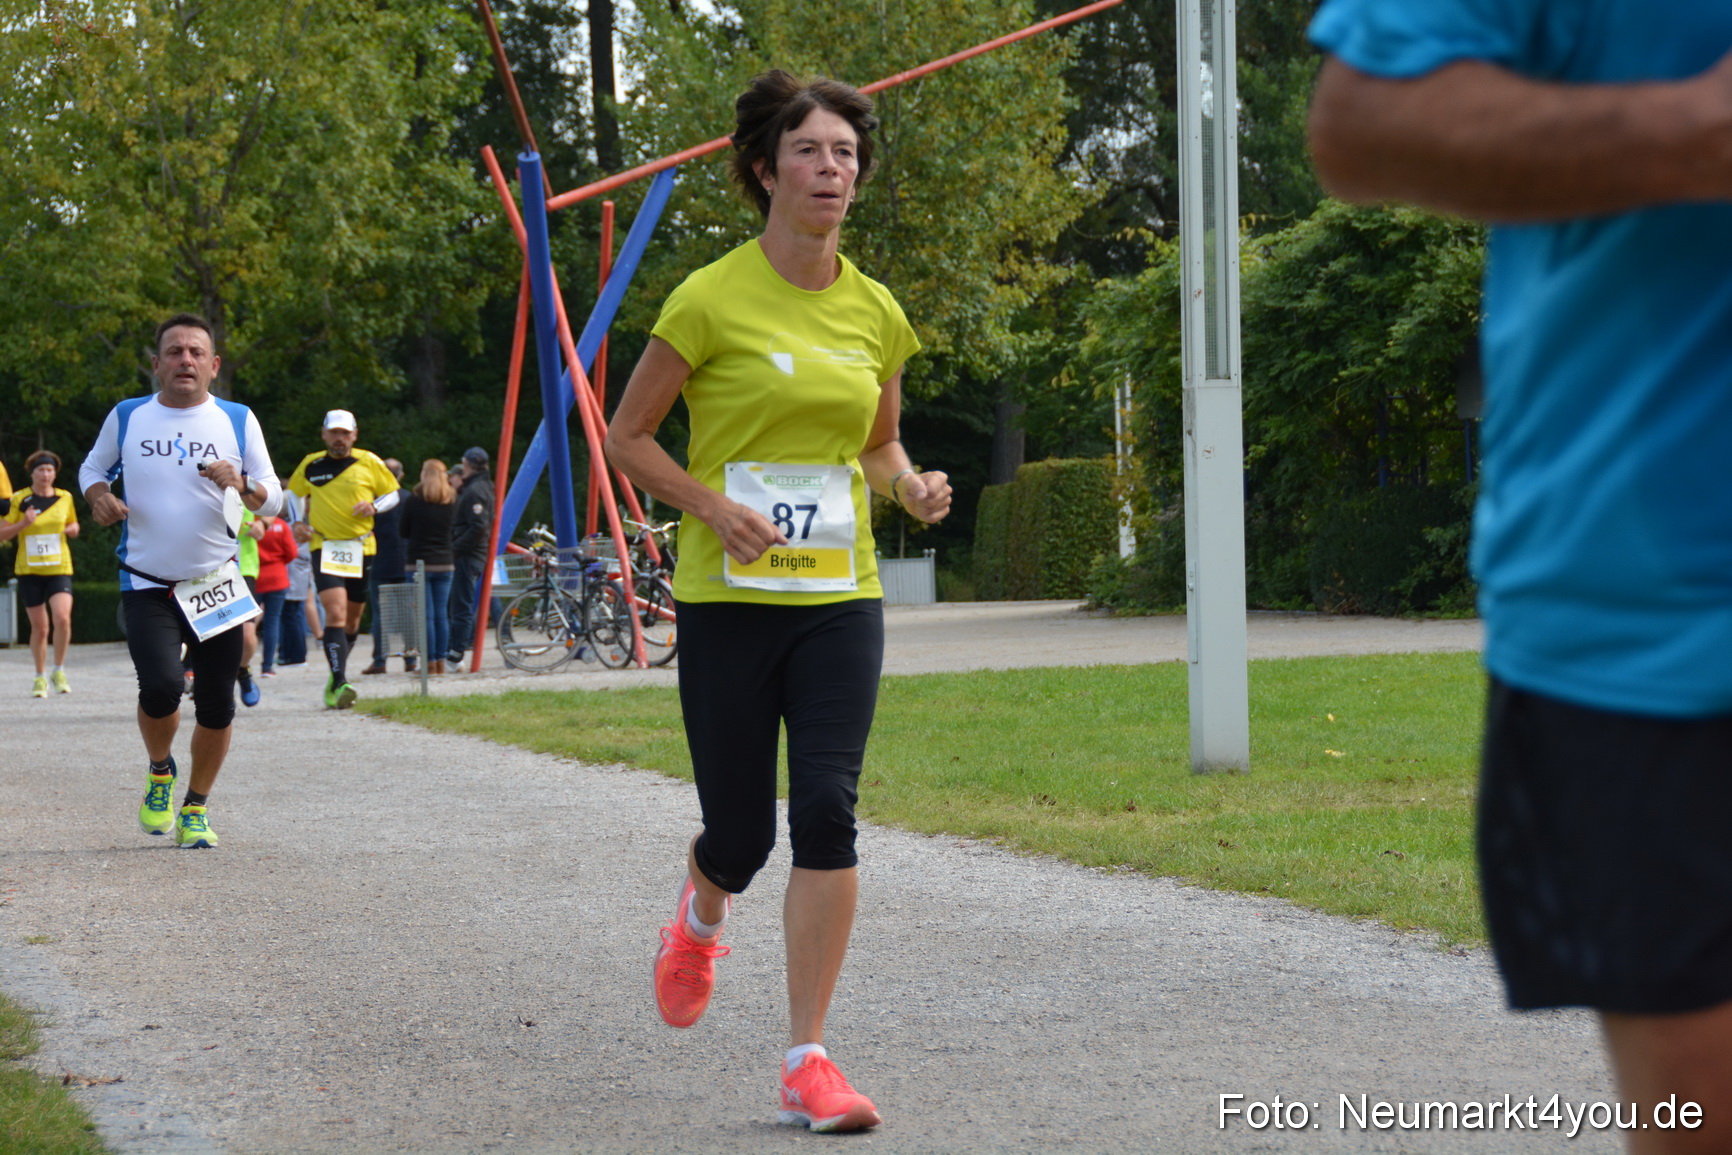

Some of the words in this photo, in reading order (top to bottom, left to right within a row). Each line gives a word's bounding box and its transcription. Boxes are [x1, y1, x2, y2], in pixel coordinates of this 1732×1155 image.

[776, 475, 823, 487] BOCK
[772, 502, 818, 540] 87
[37, 544, 49, 554] 51
[331, 550, 353, 563] 233
[770, 554, 816, 570] Brigitte
[189, 579, 235, 614] 2057
